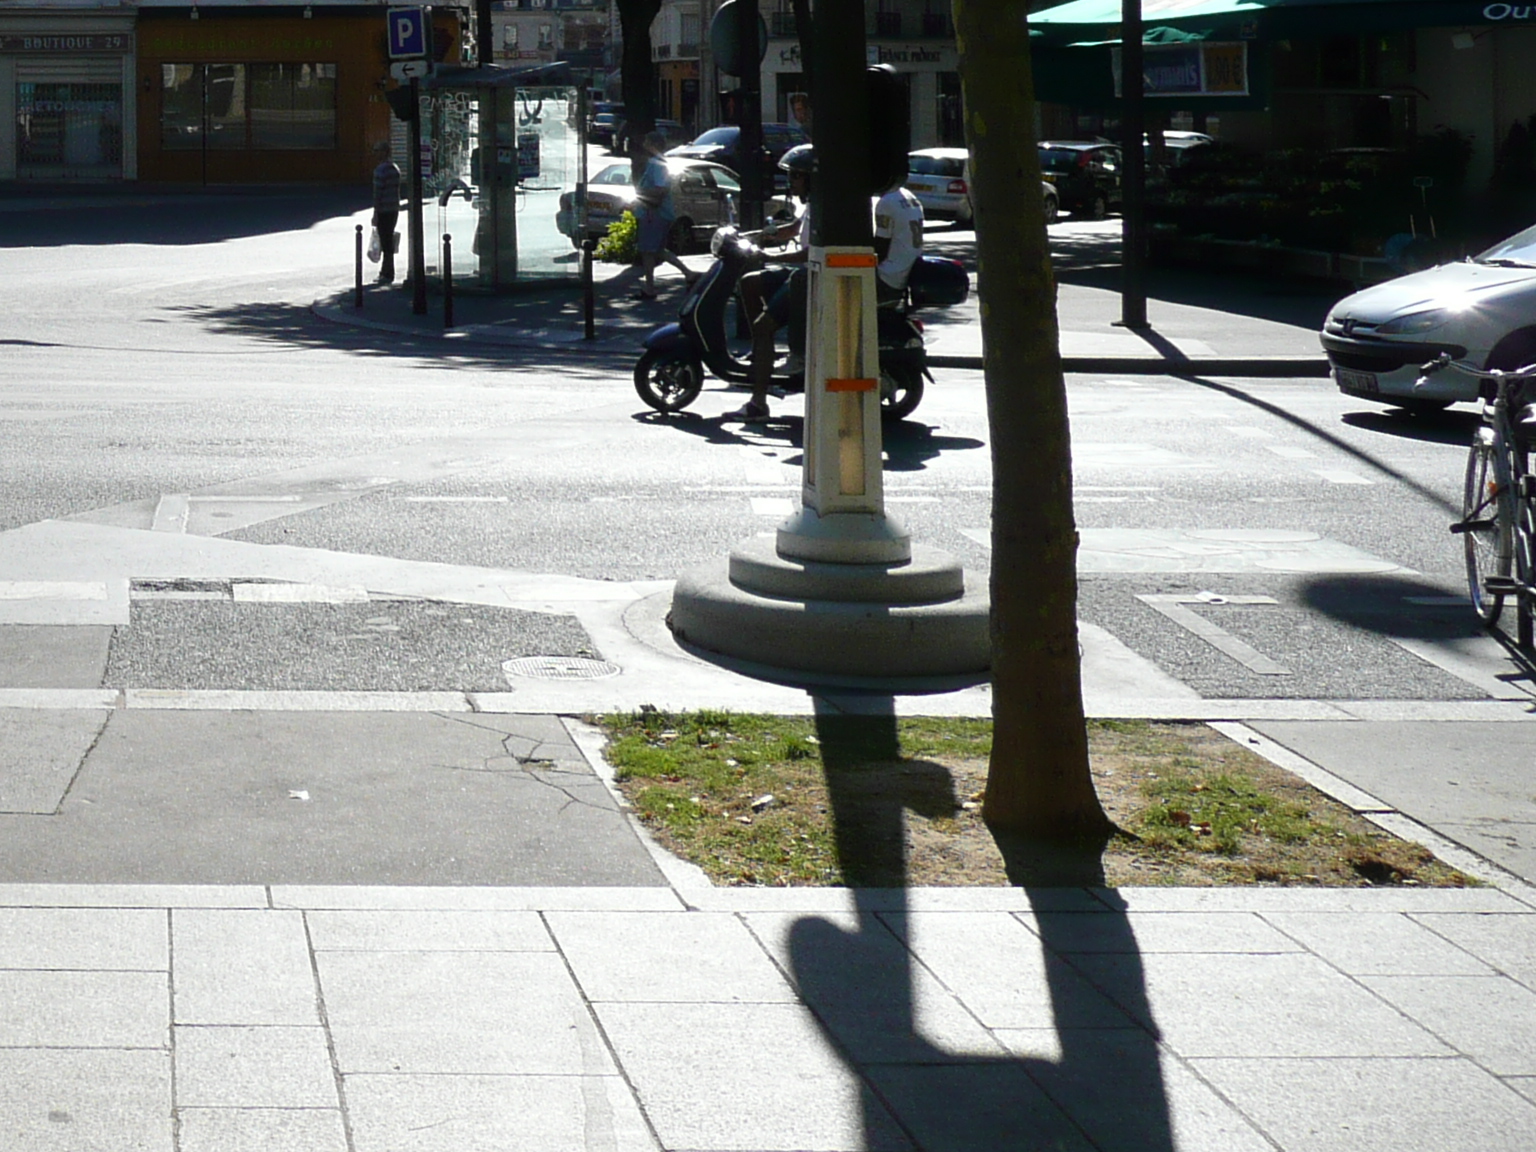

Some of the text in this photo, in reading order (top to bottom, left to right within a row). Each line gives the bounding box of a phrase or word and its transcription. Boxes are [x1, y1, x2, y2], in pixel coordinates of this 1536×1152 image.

[23, 36, 93, 50] BOUTIQUE
[105, 36, 121, 48] 29
[396, 17, 414, 48] P
